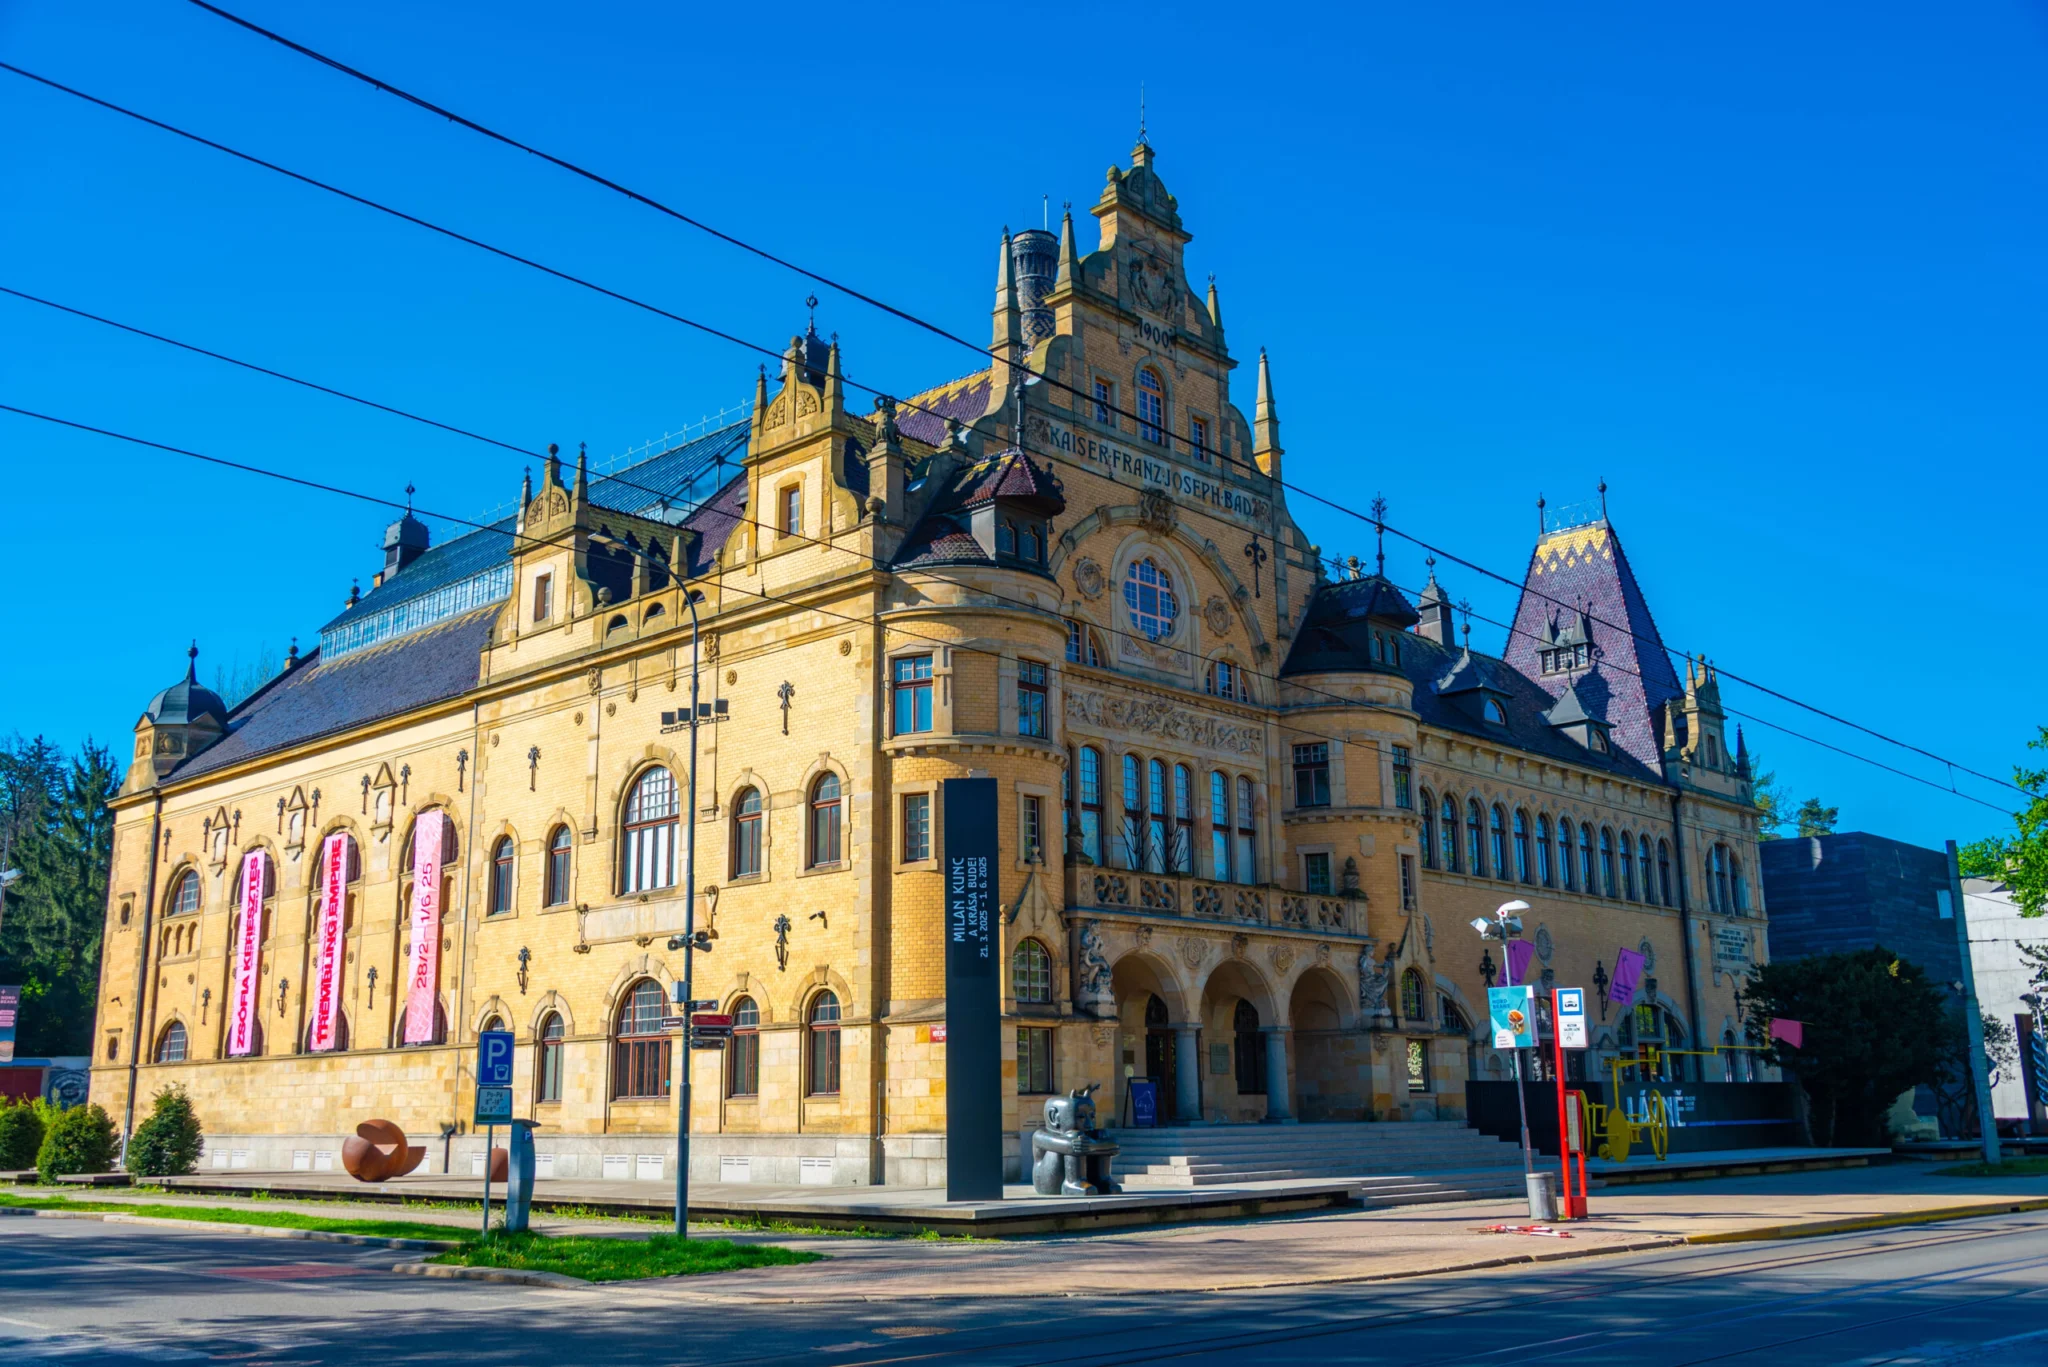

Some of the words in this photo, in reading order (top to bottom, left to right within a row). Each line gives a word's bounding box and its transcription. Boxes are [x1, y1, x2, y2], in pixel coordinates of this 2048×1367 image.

[1139, 321, 1170, 348] 1900
[1049, 426, 1109, 465] KAISER
[1113, 451, 1162, 483] FRANZ
[1165, 468, 1221, 504] JOSEPH
[1224, 490, 1252, 515] BAD
[422, 863, 432, 887] 25
[953, 857, 964, 894] KUNC
[967, 857, 977, 888] BUDE!
[979, 857, 987, 878] 2025
[979, 880, 987, 889] 6.
[980, 891, 987, 899] 1.
[953, 901, 965, 942] MILAN
[967, 892, 978, 926] KRÁSA
[980, 910, 988, 932] 2025
[316, 923, 337, 1044] TREMBLING
[328, 839, 342, 920] EMPIRE
[968, 928, 978, 937] A
[980, 934, 988, 942] 3.
[236, 975, 249, 1048] ZSÓFIA
[243, 857, 259, 971] KERESZTES
[980, 944, 988, 958] 21.
[487, 1039, 507, 1068] P
[525, 1131, 531, 1140] P
